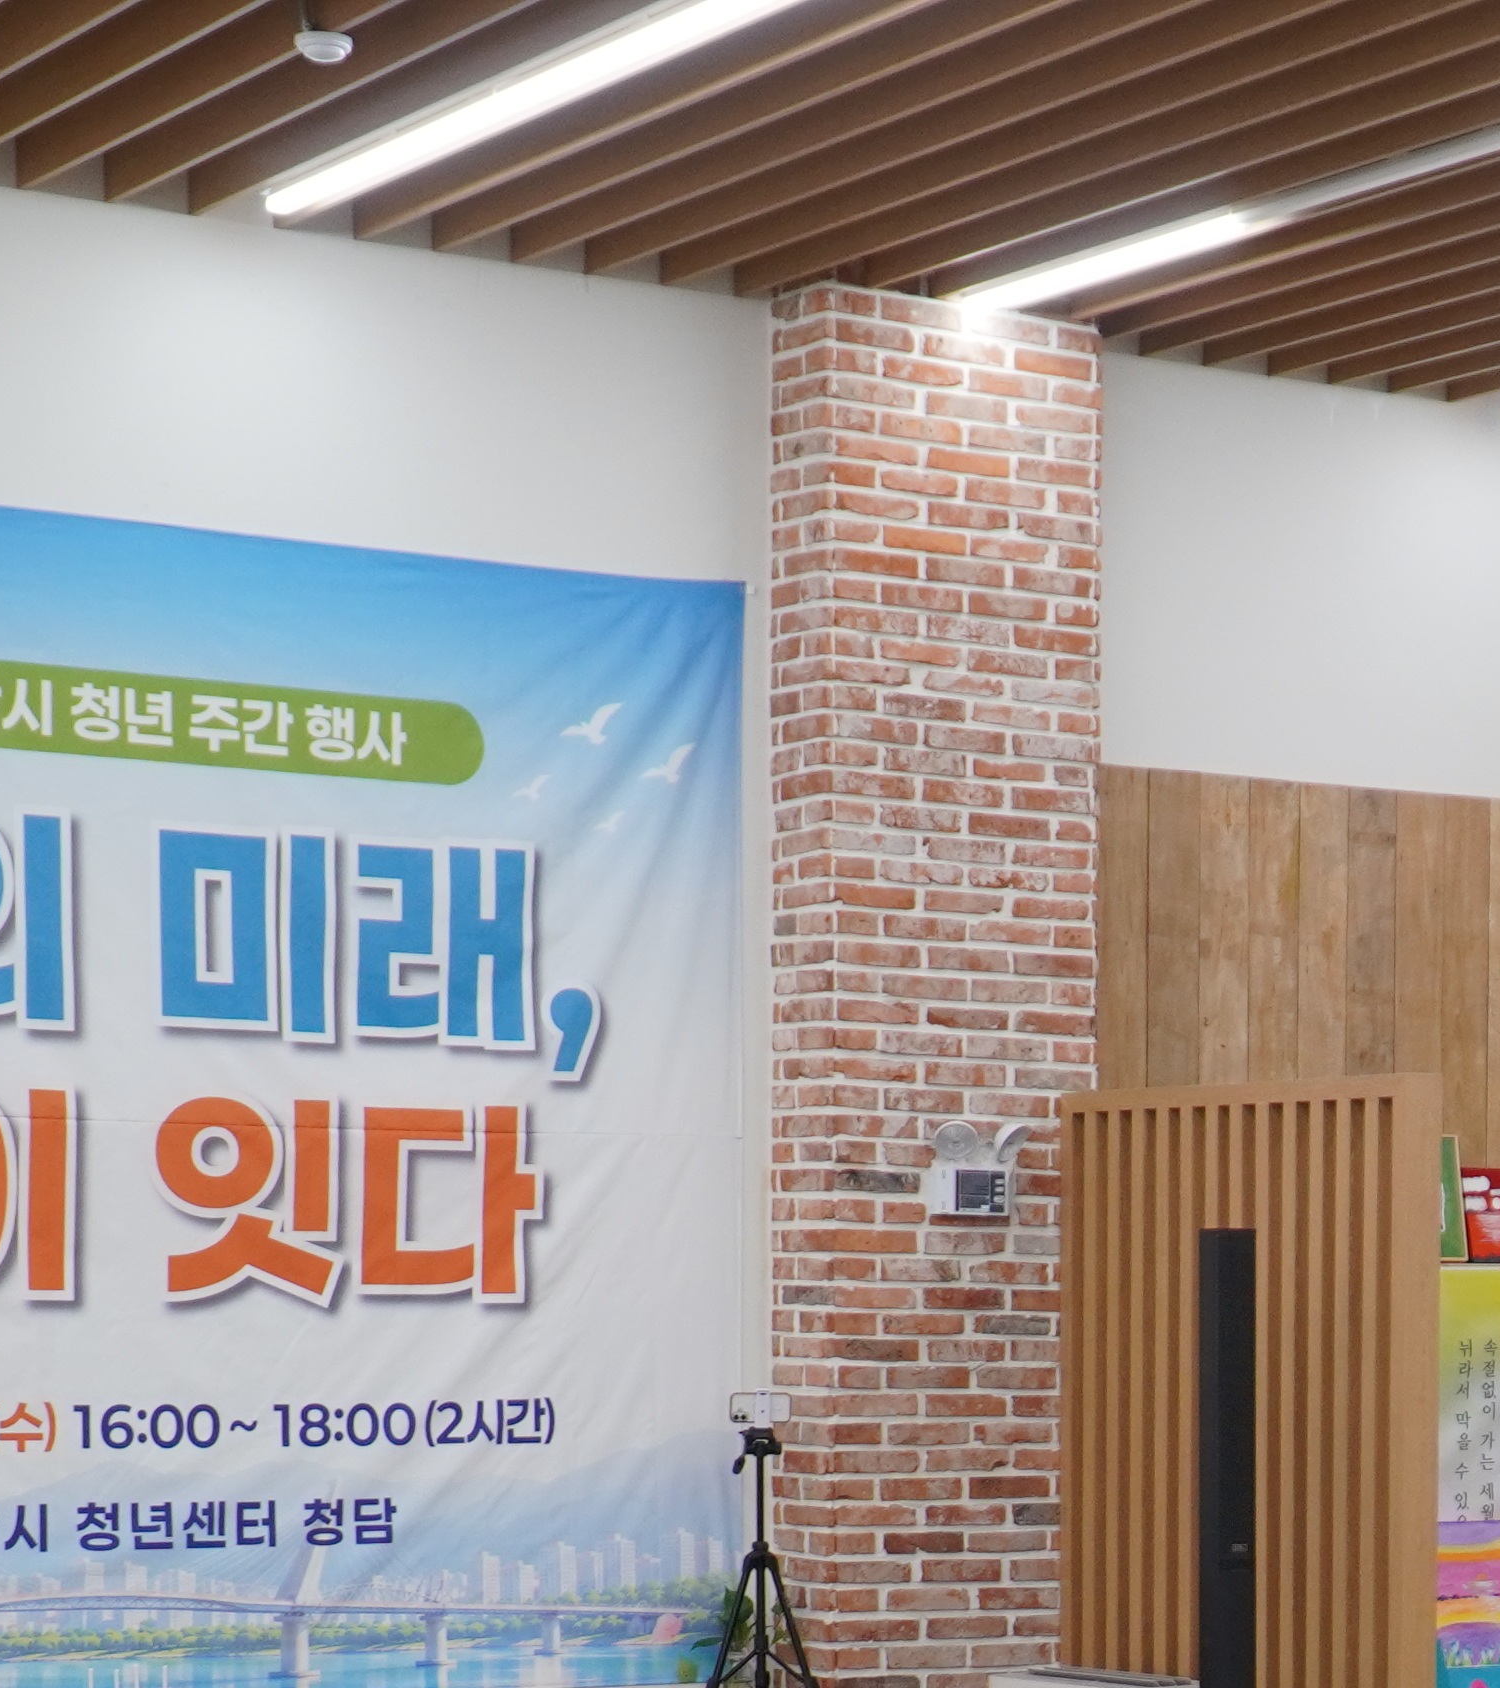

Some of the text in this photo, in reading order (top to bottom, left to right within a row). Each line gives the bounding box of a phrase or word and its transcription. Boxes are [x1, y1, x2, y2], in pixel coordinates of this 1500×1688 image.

[70, 681, 176, 749] 청년
[188, 692, 296, 759] 주간
[304, 702, 409, 768] 행사
[157, 829, 596, 1074] 미래,
[155, 1096, 542, 1302] 잇다
[1456, 1339, 1473, 1399] 뉘라서
[1482, 1338, 1498, 1420] 속절없이
[73, 1404, 220, 1450] 16:00
[273, 1403, 416, 1448] 18:00
[424, 1398, 556, 1448] (2시간)
[1456, 1411, 1471, 1451] 막을
[1480, 1431, 1495, 1470] 가는
[1455, 1463, 1469, 1480] 수
[76, 1500, 277, 1553] 청년센터
[303, 1497, 398, 1547] 청담
